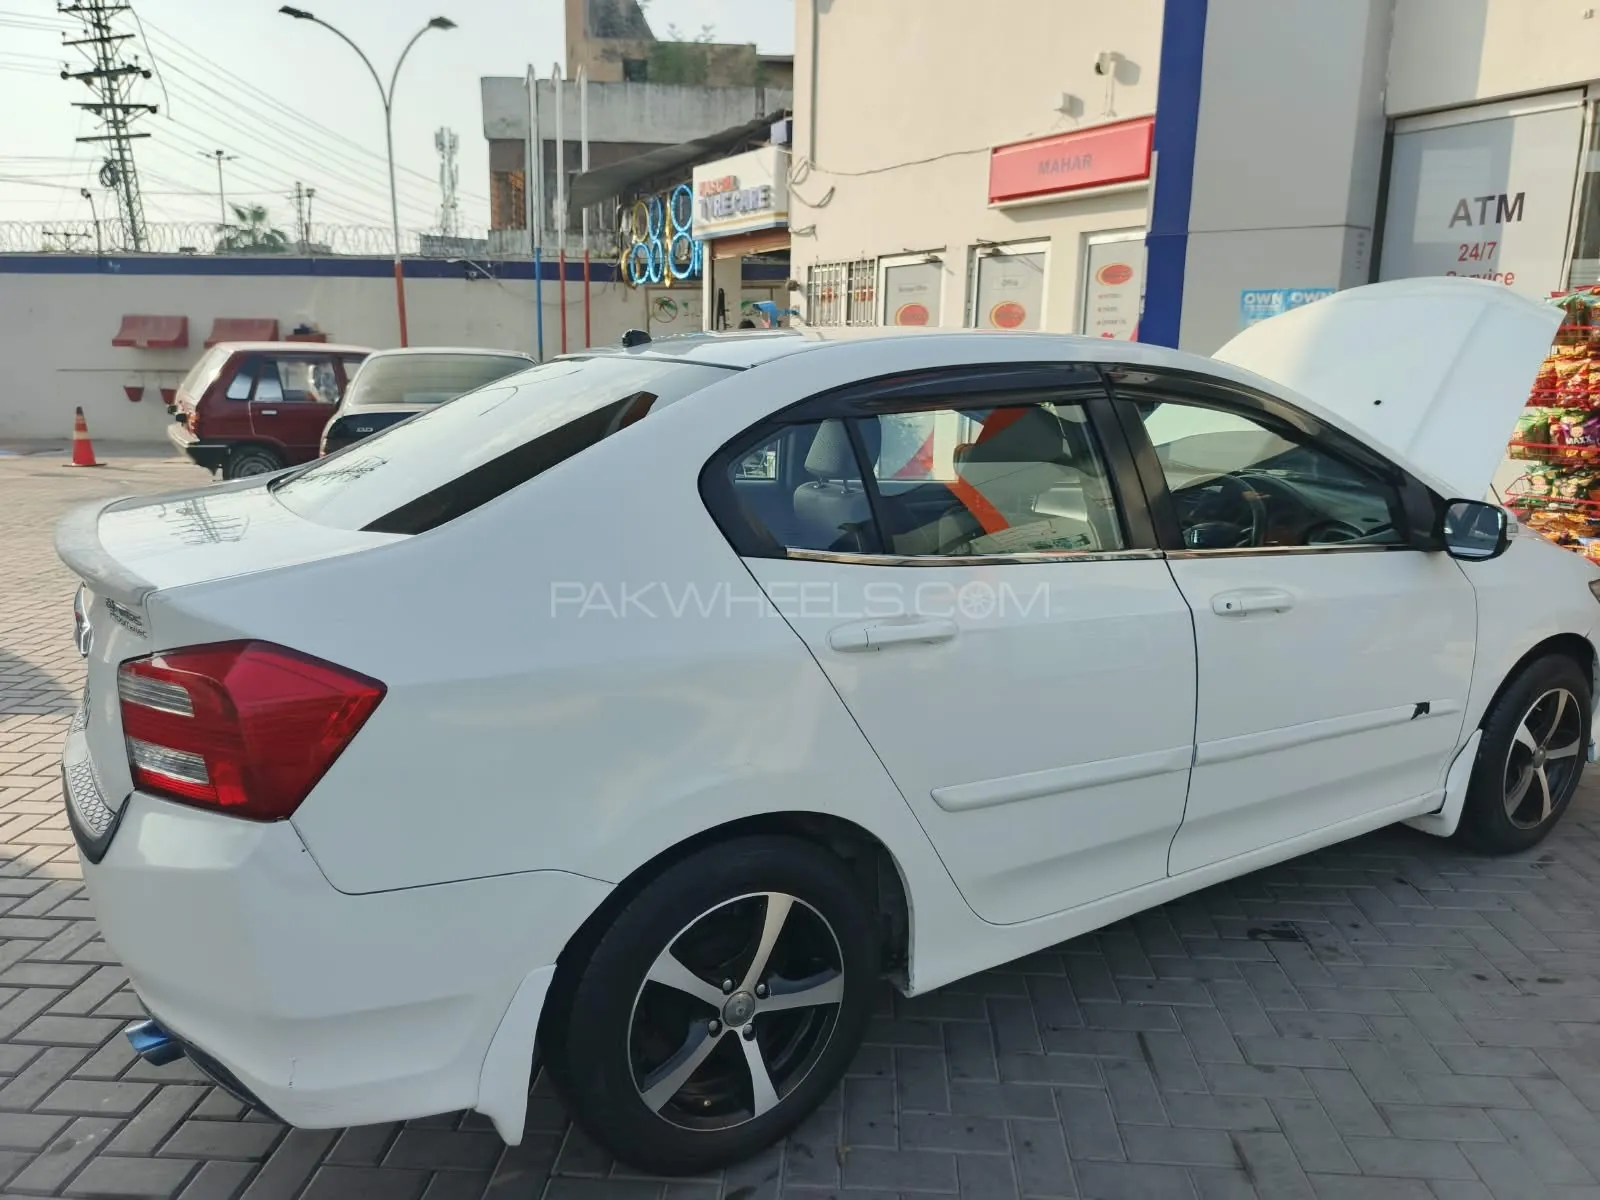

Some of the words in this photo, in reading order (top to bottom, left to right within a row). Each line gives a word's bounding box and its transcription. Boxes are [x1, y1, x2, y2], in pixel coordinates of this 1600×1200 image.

[1037, 154, 1093, 175] MAHAR
[1448, 192, 1525, 228] ATM
[1458, 241, 1497, 262] 24/7
[1446, 268, 1515, 286] vice
[1244, 293, 1284, 305] OWN
[1291, 291, 1334, 304] OW
